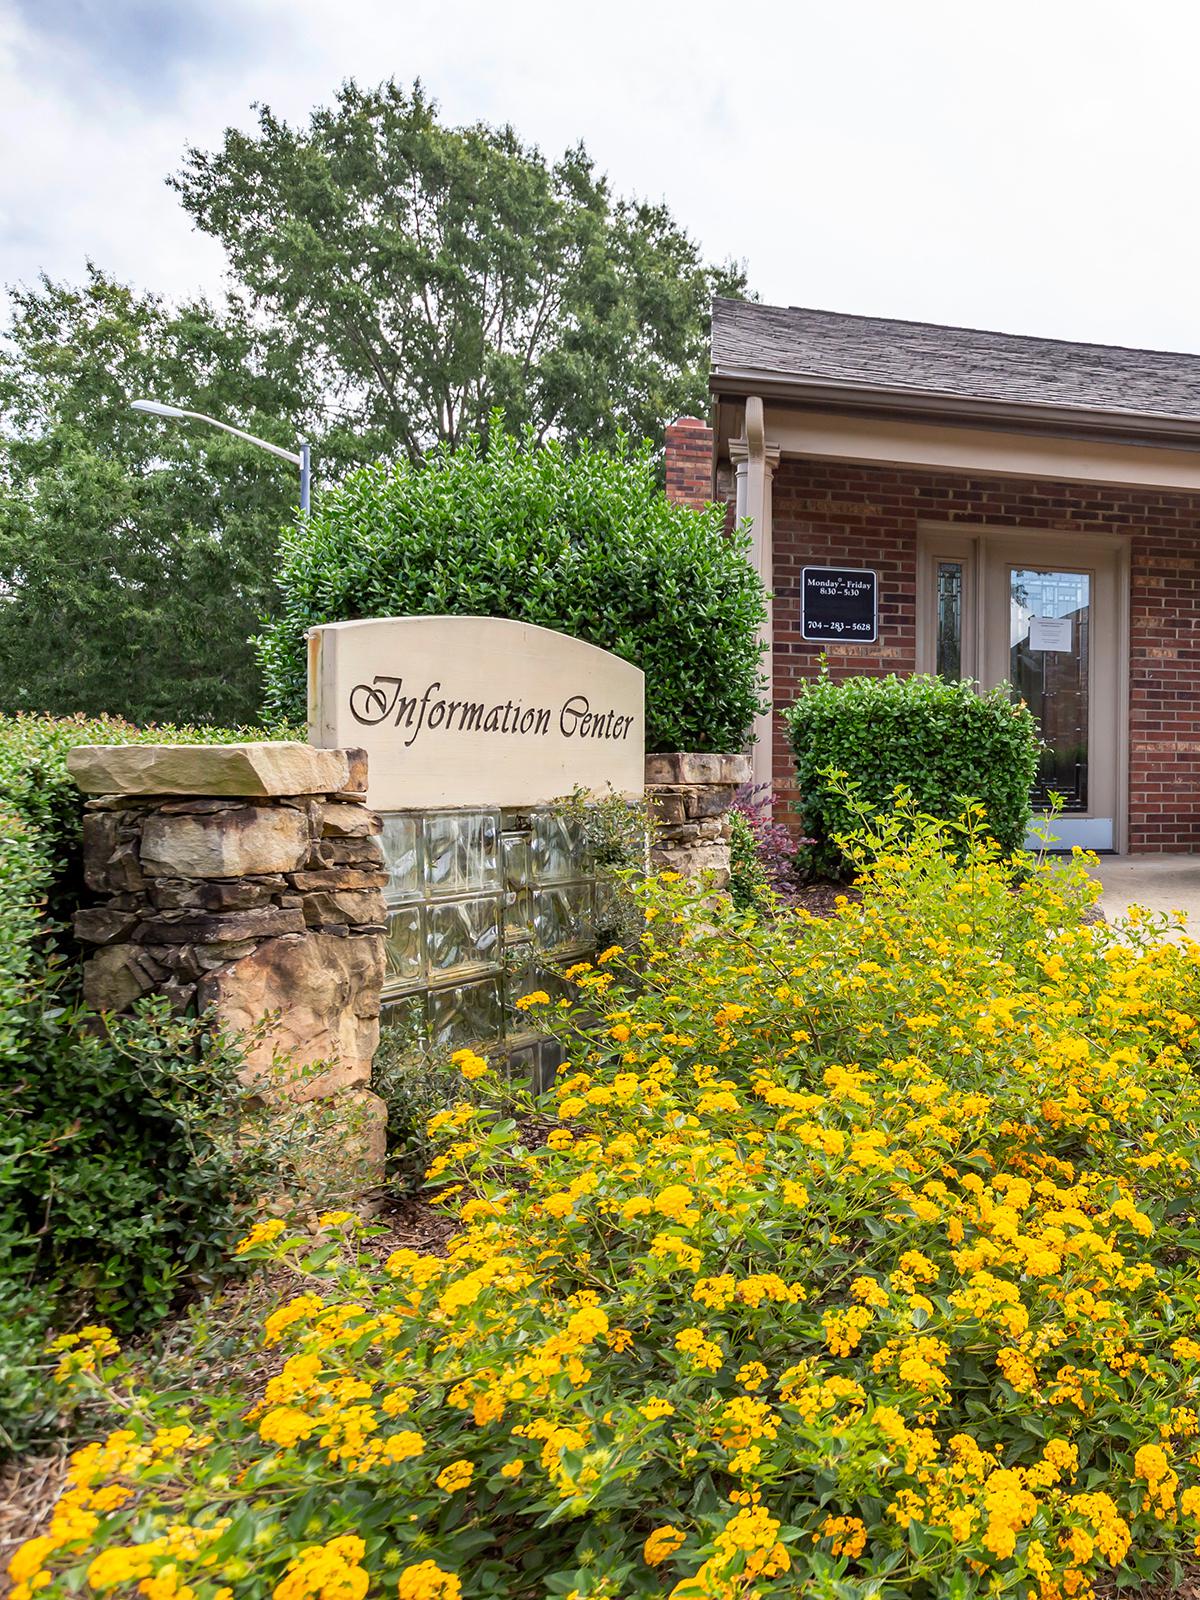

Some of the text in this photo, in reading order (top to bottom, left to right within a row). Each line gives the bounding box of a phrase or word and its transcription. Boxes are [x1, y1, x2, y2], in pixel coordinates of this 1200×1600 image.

[808, 578, 839, 588] Monday
[847, 581, 871, 590] Friday
[820, 587, 836, 595] 8:30
[349, 675, 634, 747] Information Center
